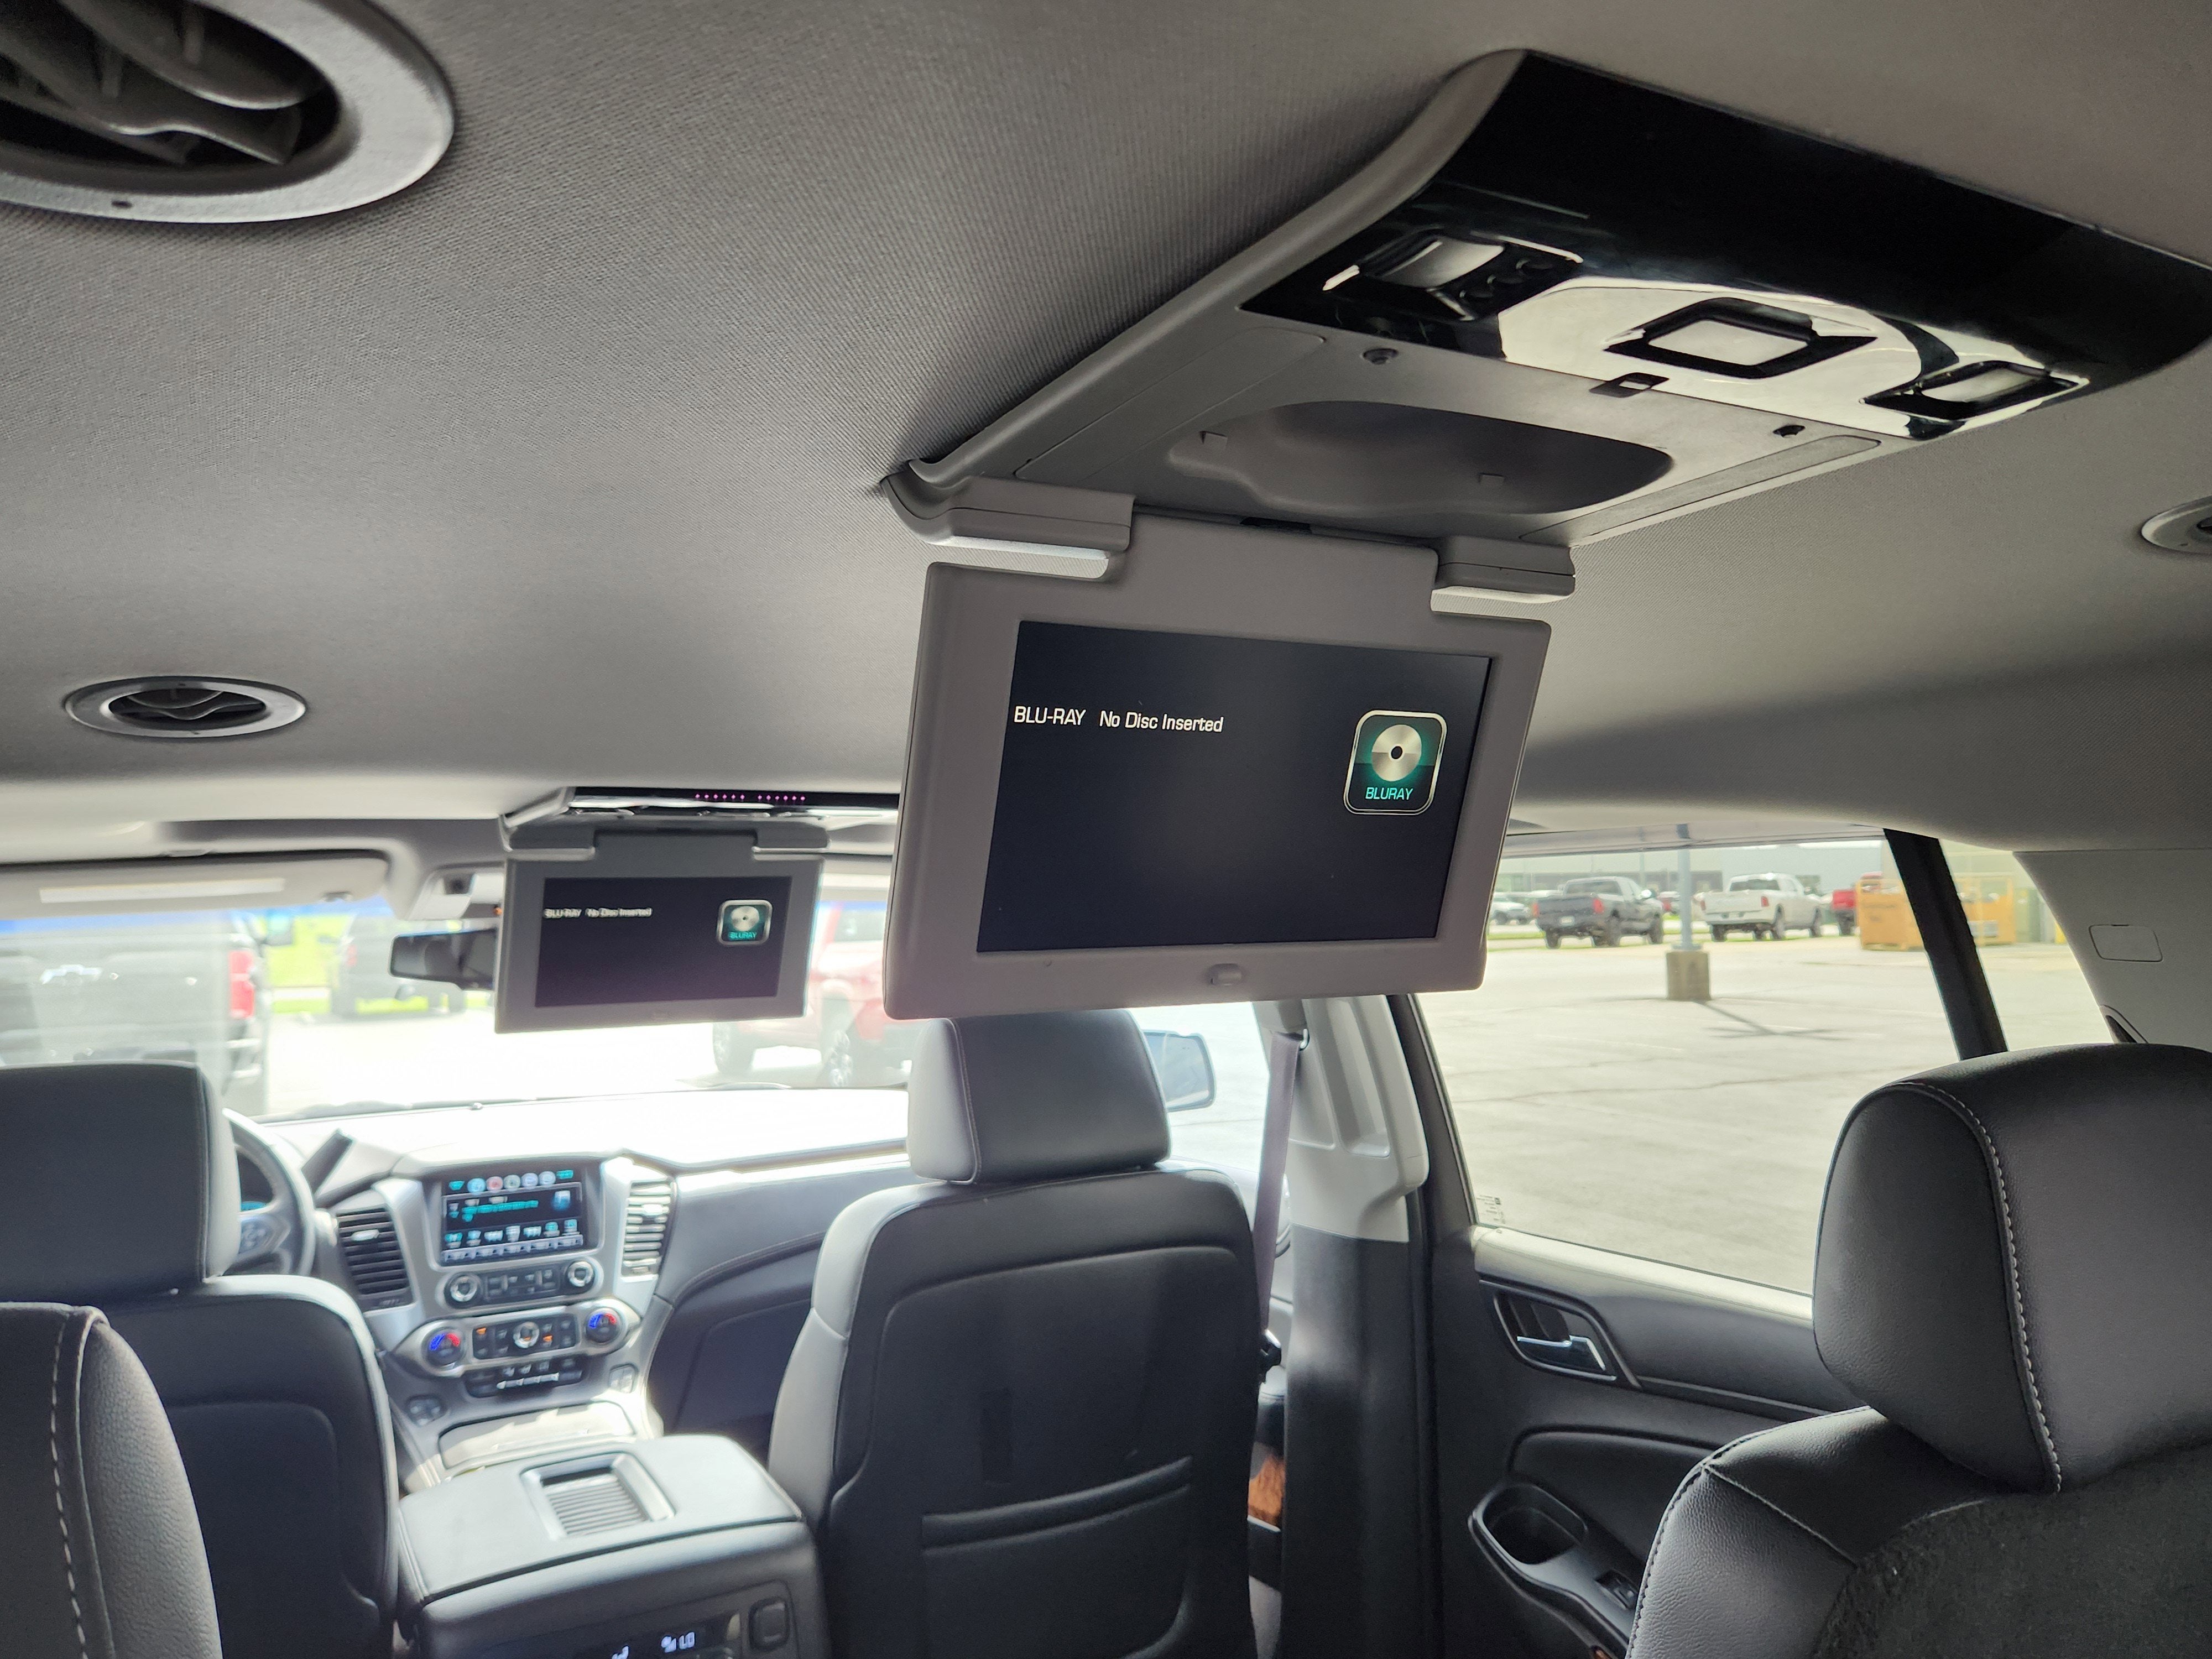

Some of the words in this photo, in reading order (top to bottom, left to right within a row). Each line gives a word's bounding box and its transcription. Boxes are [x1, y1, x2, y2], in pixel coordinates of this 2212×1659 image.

[1014, 705, 1086, 726] BLU-RAY
[1099, 710, 1120, 728] No
[1125, 712, 1158, 729] Disc
[1162, 713, 1224, 733] Inserted
[1365, 787, 1413, 800] BLURAY
[729, 931, 757, 940] BLURAY
